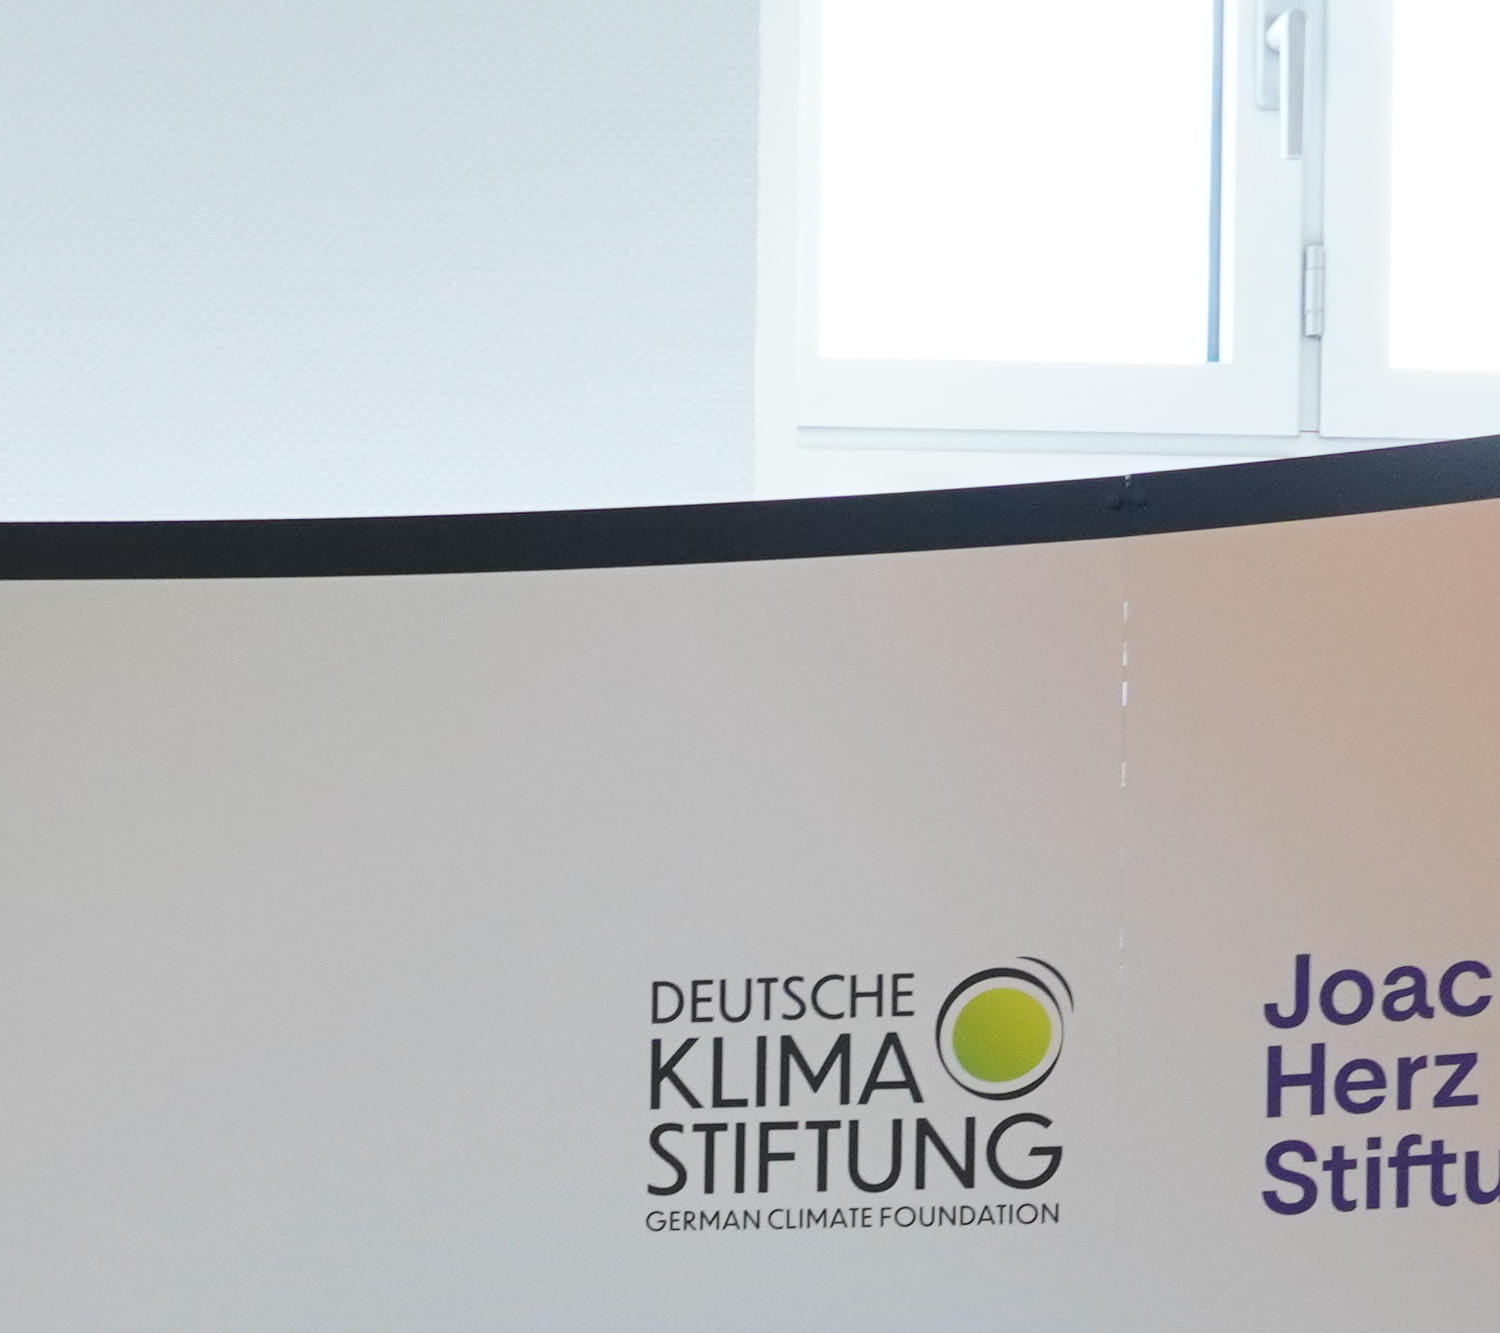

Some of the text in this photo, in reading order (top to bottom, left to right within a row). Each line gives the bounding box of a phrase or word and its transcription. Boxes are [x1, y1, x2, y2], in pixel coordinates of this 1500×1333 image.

[650, 972, 915, 1025] DEUTSCHE
[650, 1031, 925, 1110] KLIMA
[1266, 1042, 1479, 1118] Herz
[647, 1112, 1063, 1197] STIFTUNG
[645, 1202, 1060, 1232] GERMAN CLIMATE FOUNDATION
